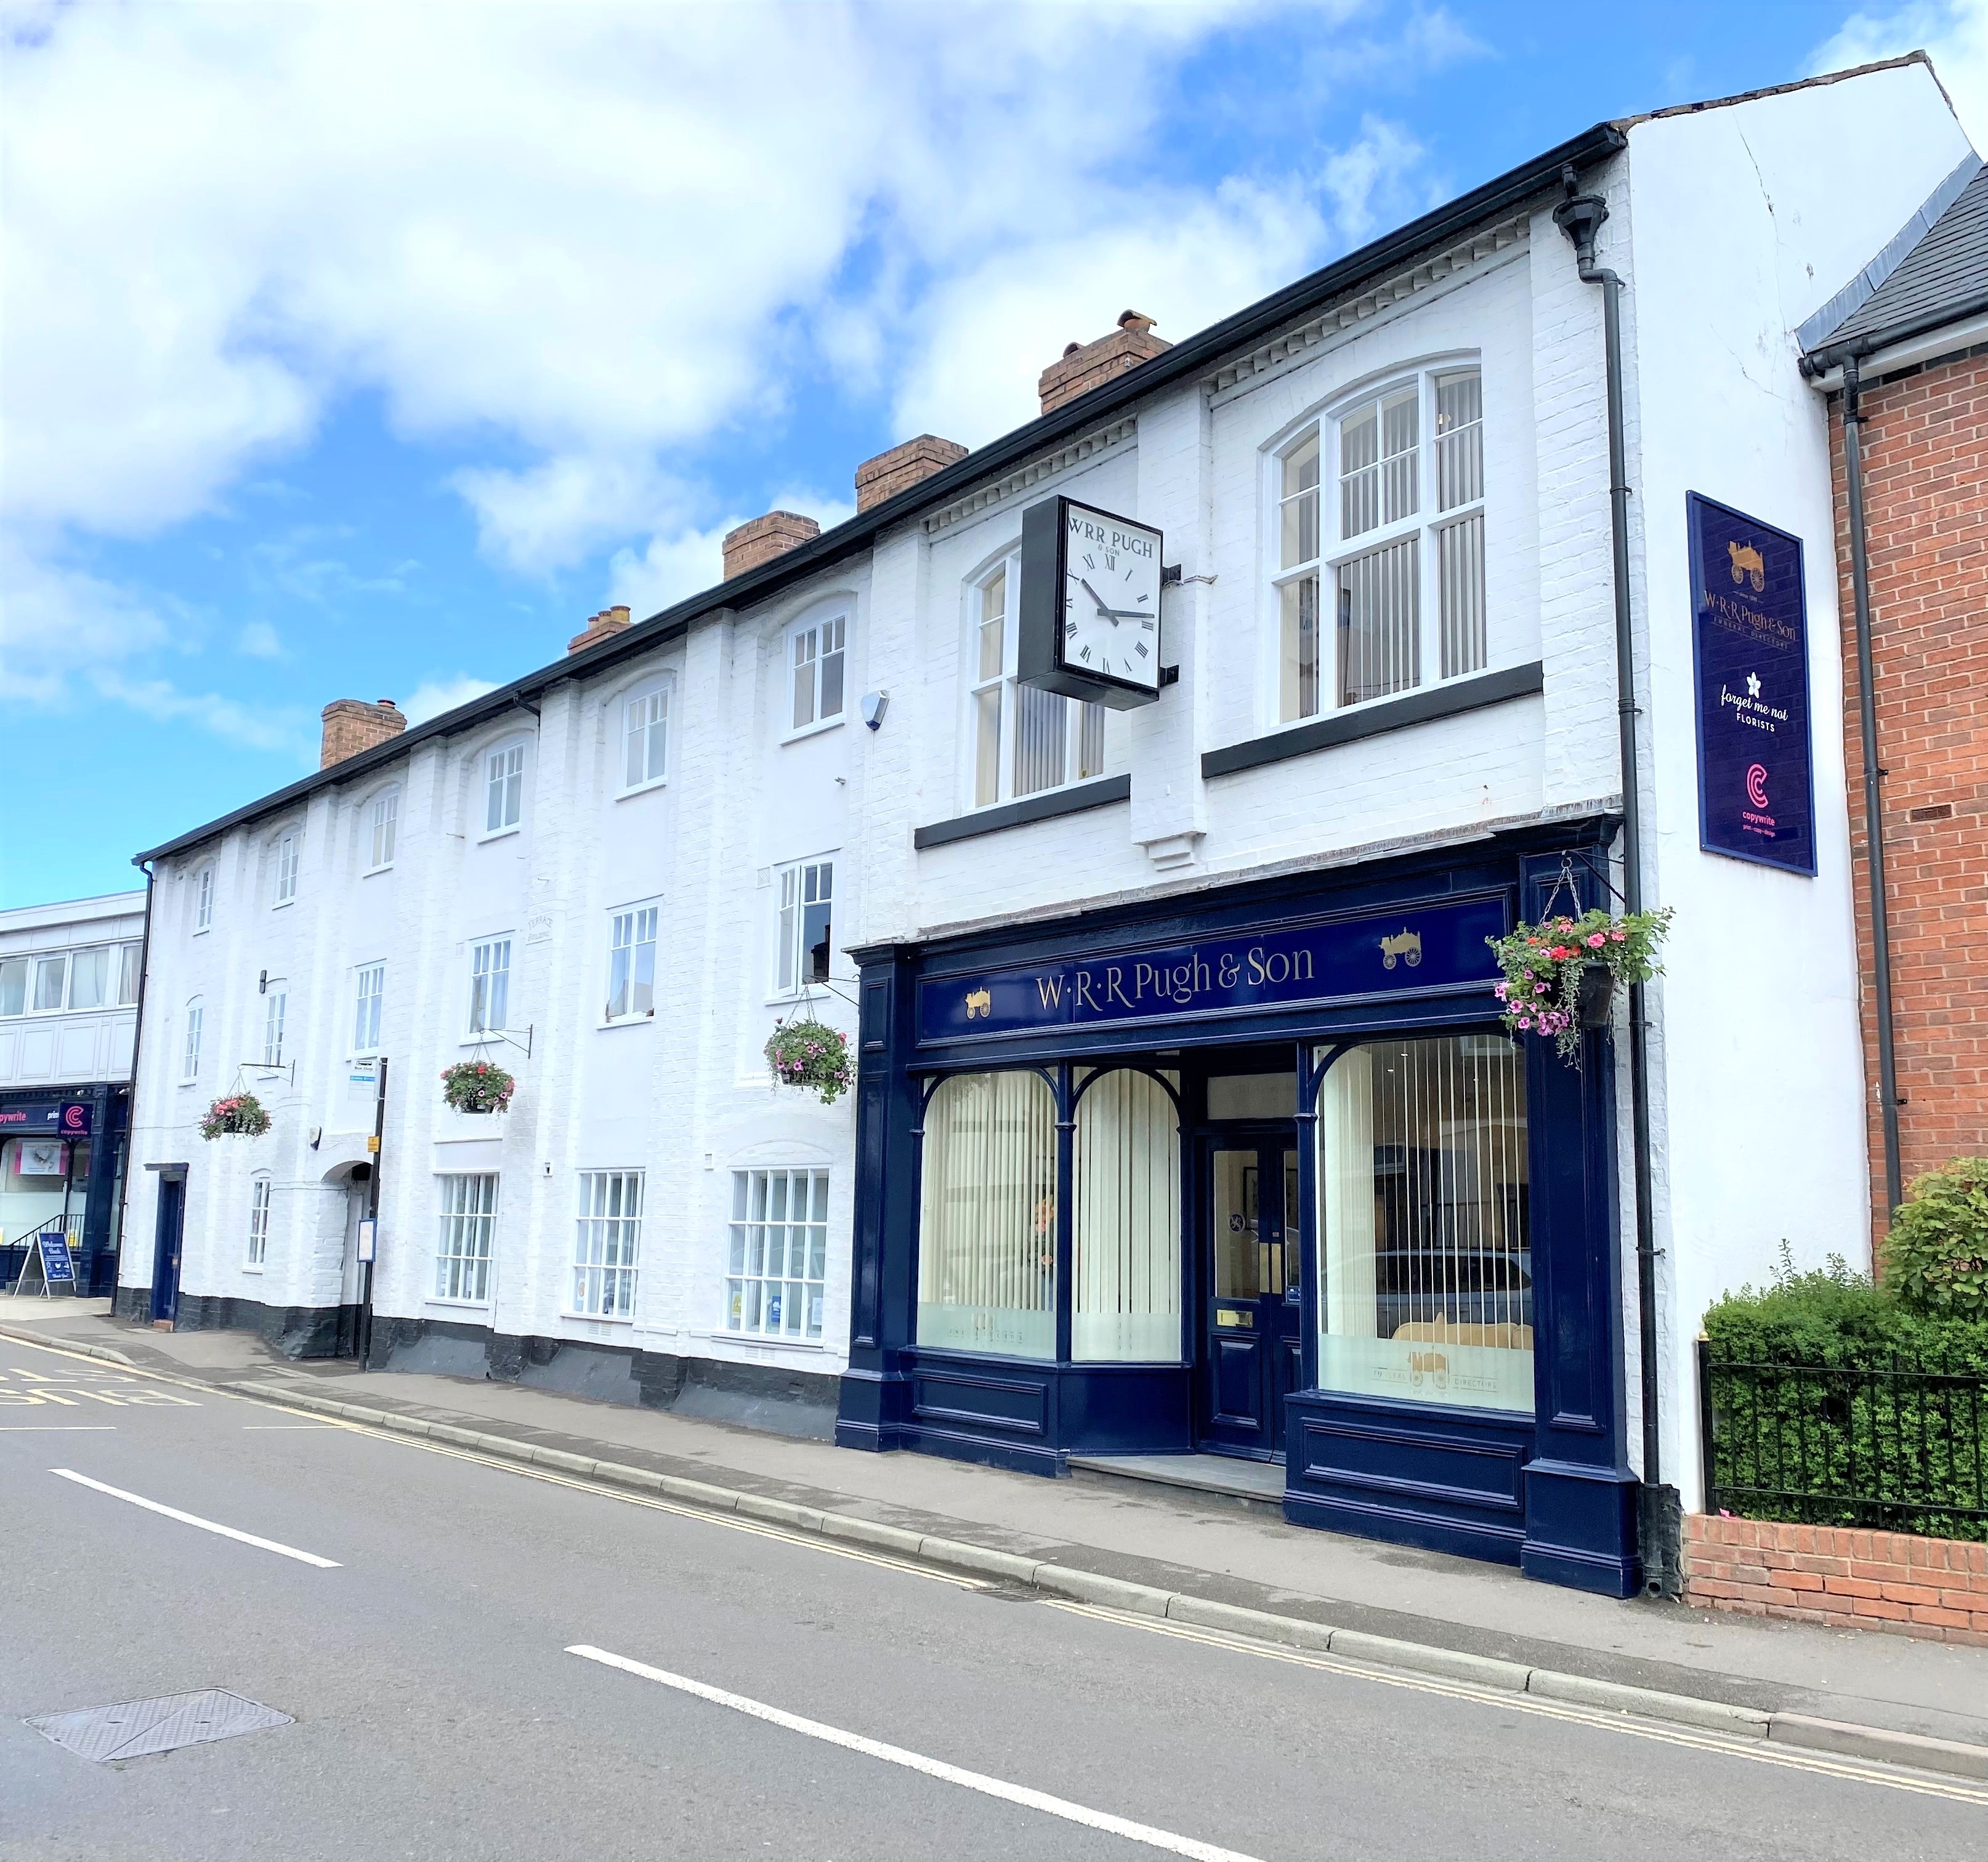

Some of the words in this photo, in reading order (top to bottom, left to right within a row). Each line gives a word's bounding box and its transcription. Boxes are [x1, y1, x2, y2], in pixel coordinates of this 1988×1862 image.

[1069, 517, 1105, 543] WRR
[1112, 531, 1153, 558] PUGH
[1105, 547, 1120, 556] SON
[1105, 554, 1115, 571] XII
[1741, 605, 1767, 631] Pugh
[1769, 618, 1776, 632] &
[1777, 620, 1796, 640] Son
[1721, 684, 1753, 711] forget
[1754, 703, 1770, 714] me
[1771, 708, 1788, 721] not
[1737, 713, 1774, 732] FLORISTS
[1742, 812, 1775, 826] copywrite
[528, 916, 553, 930] TERRACE
[1134, 952, 1210, 1003] Pugh
[1218, 953, 1240, 988] &
[1248, 946, 1315, 986] Son
[0, 1110, 26, 1124] pywrite
[47, 1110, 59, 1121] prin
